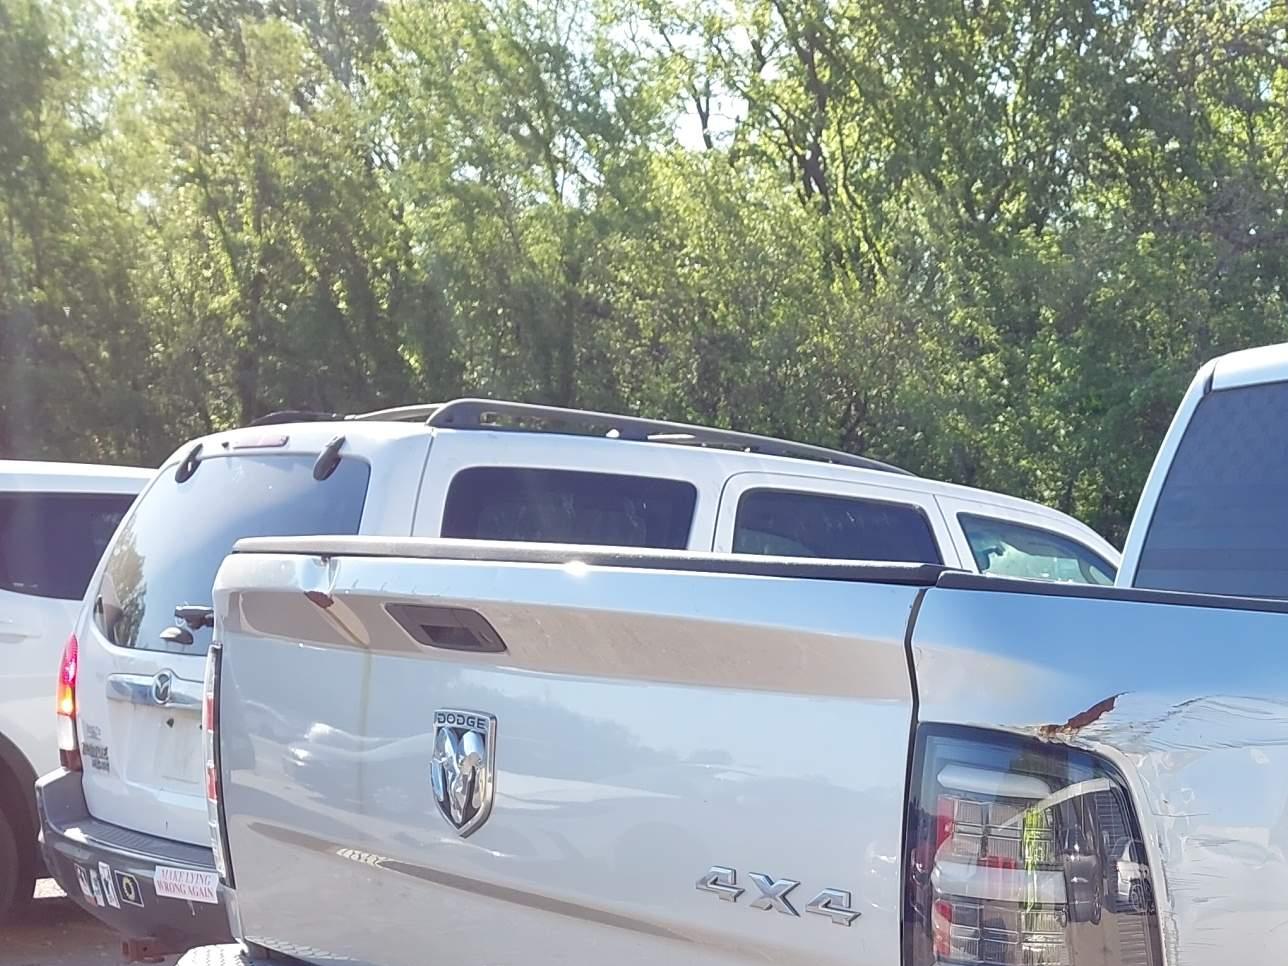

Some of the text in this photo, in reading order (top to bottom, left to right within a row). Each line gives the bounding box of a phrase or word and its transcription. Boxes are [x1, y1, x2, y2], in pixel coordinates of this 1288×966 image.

[437, 713, 487, 730] DODGE
[157, 880, 214, 897] WRONG AGAIN
